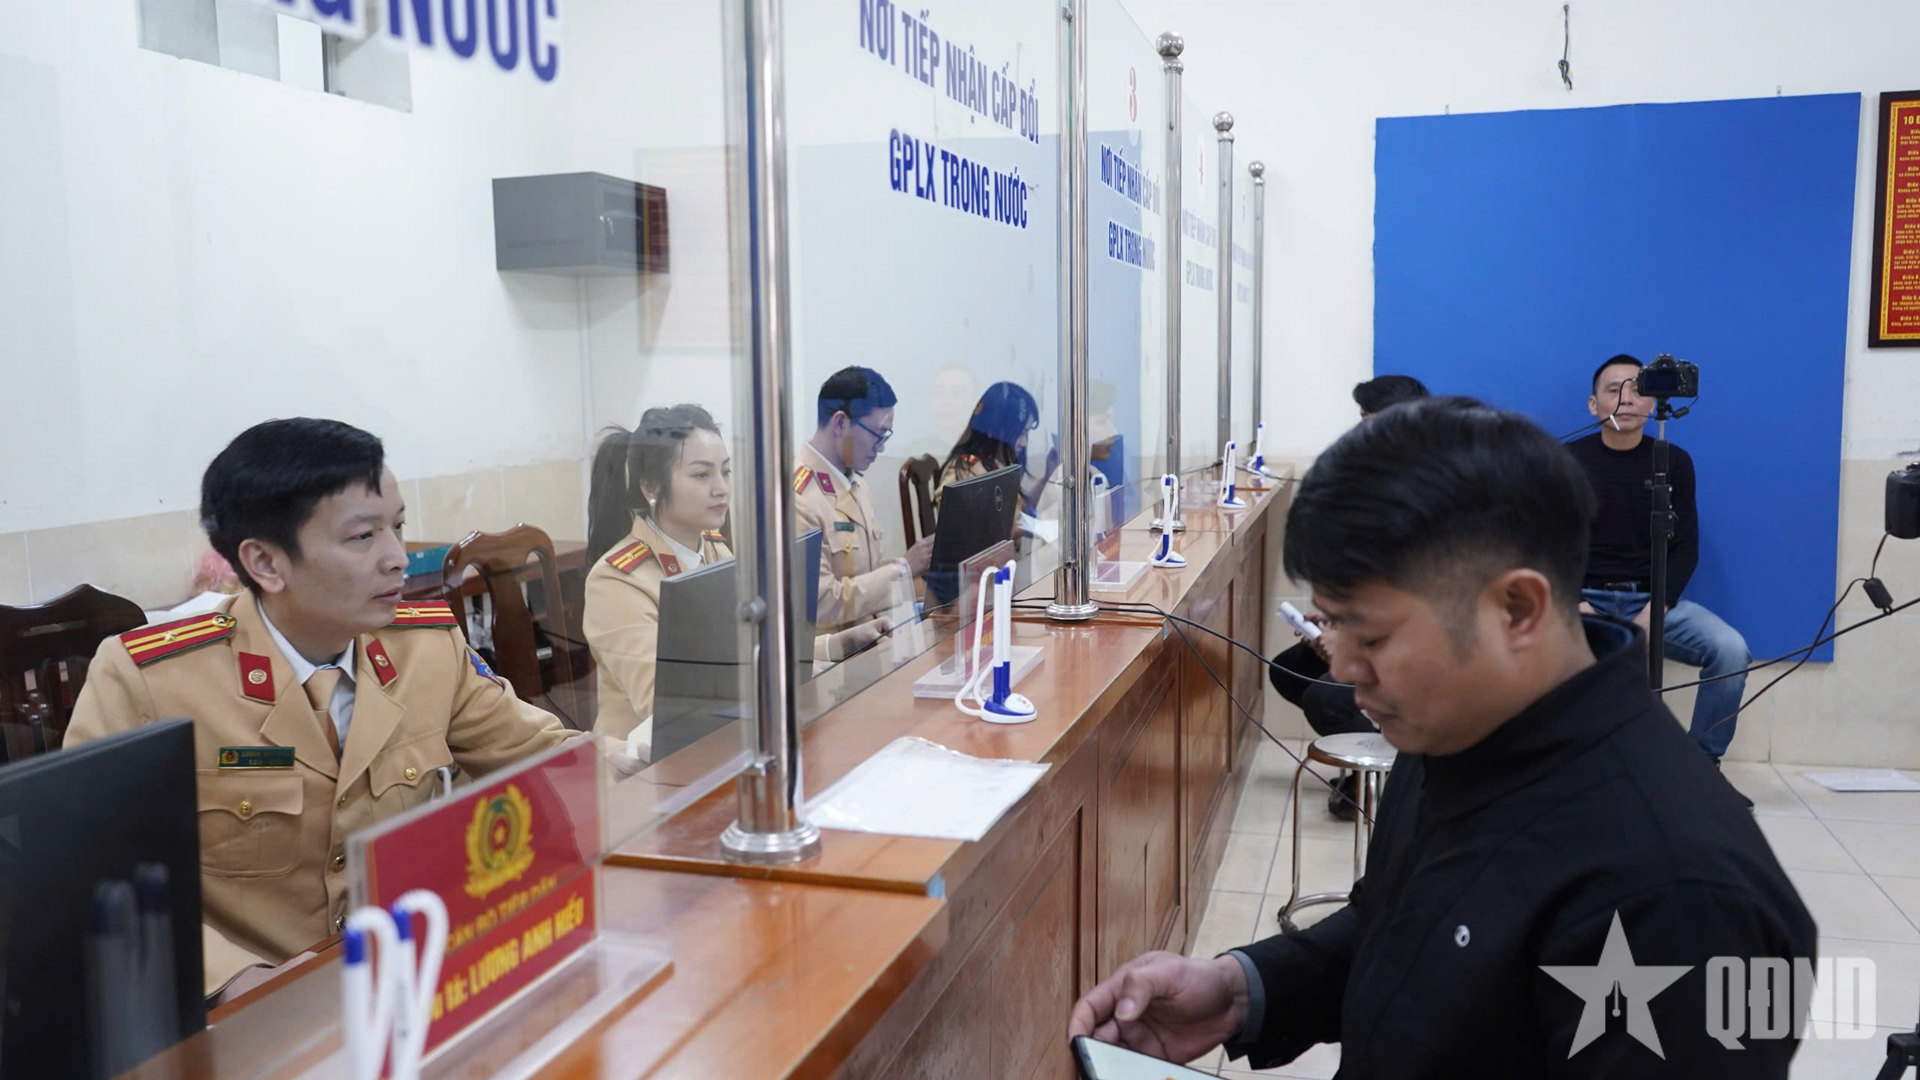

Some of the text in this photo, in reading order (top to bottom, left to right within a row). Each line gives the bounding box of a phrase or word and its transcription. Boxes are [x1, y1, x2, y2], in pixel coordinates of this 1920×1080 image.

[902, 9, 940, 88] TIẾP
[946, 41, 988, 124] NHẬN
[992, 61, 1016, 130] CẤP
[1020, 78, 1039, 145] ĐỔI
[1904, 115, 1914, 125] 10
[890, 128, 1027, 229] GPLX TRONG NƯỚC
[1109, 220, 1123, 261] GPLX
[521, 917, 553, 962] ANH
